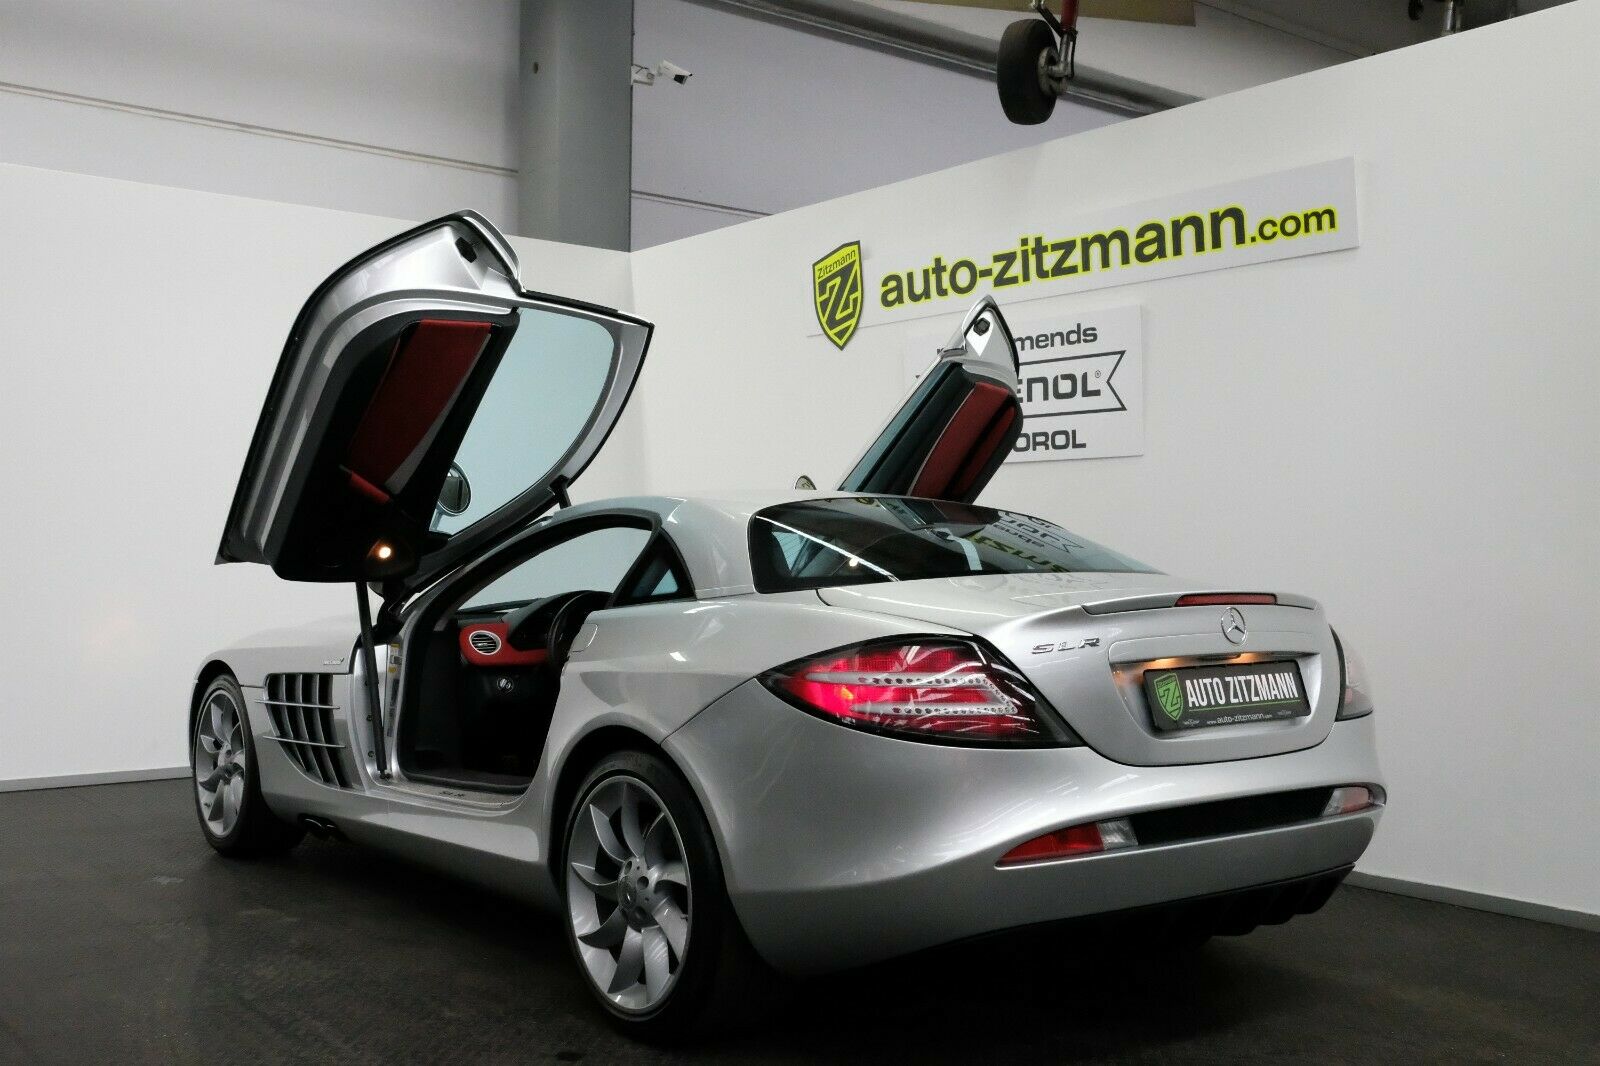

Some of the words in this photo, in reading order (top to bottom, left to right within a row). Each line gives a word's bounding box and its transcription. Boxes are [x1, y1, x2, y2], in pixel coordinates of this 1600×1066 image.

[818, 250, 856, 278] Zitzmann
[880, 205, 1337, 308] auto-zitzmann.com
[1013, 322, 1098, 351] mends
[1012, 429, 1087, 452] OROL
[1031, 638, 1100, 655] SLR
[1185, 677, 1226, 708] AUTO
[1226, 672, 1299, 704] ZITZMANN
